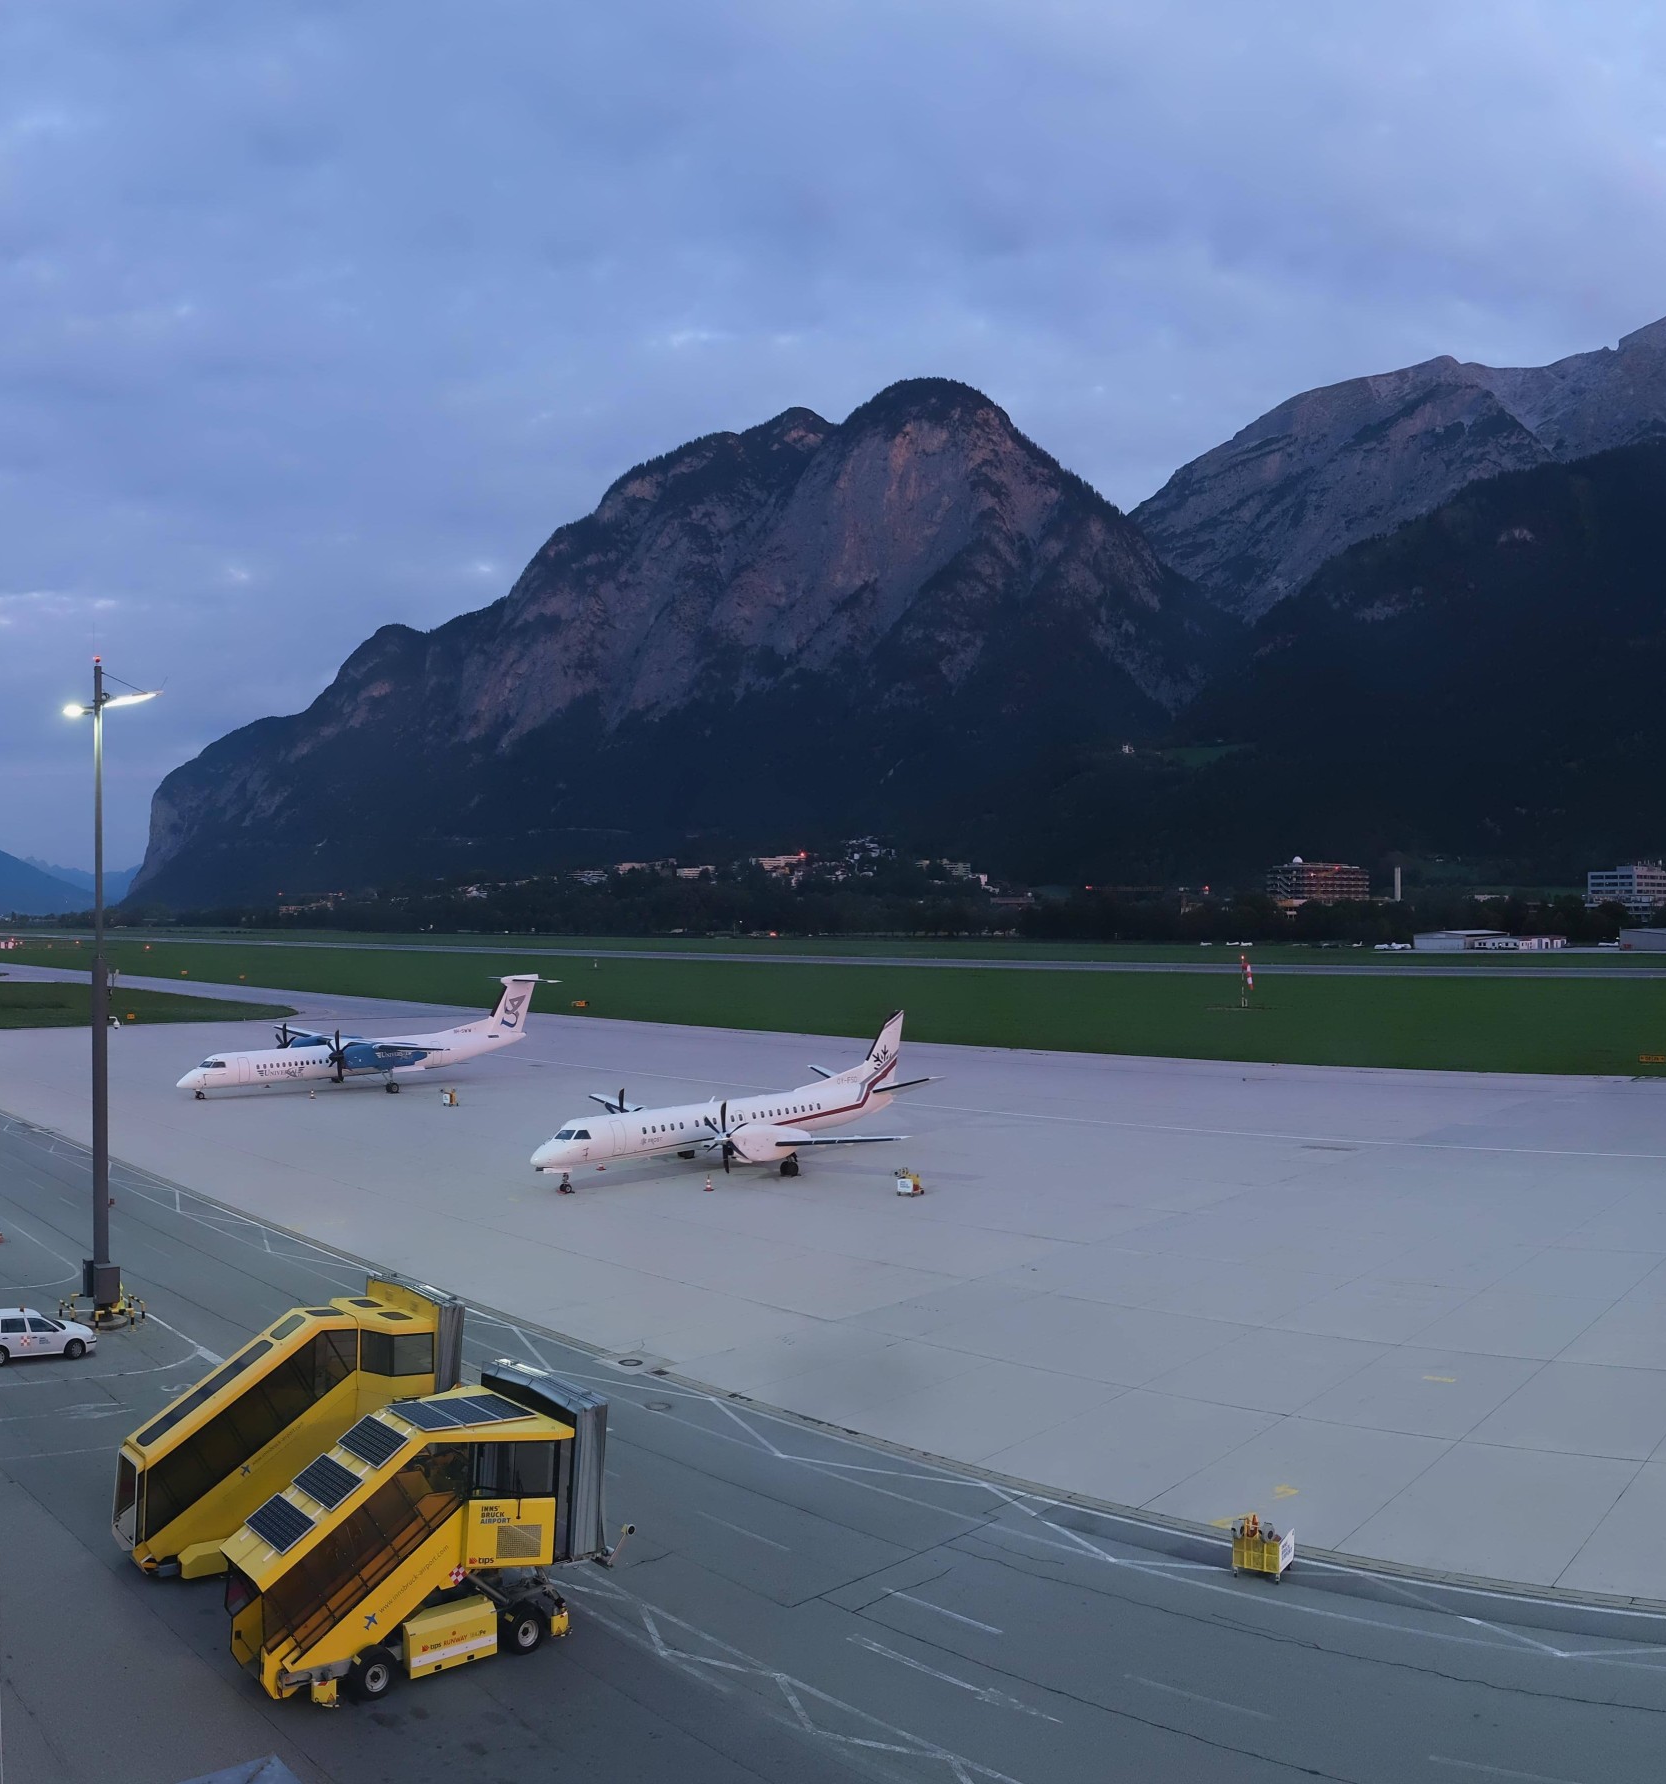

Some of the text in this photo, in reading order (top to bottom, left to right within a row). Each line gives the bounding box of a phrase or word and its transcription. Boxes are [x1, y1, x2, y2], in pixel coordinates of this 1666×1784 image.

[478, 1557, 495, 1565] tips
[378, 1544, 450, 1614] www.innsbruck-airport.com
[443, 1634, 468, 1646] RUNWAY
